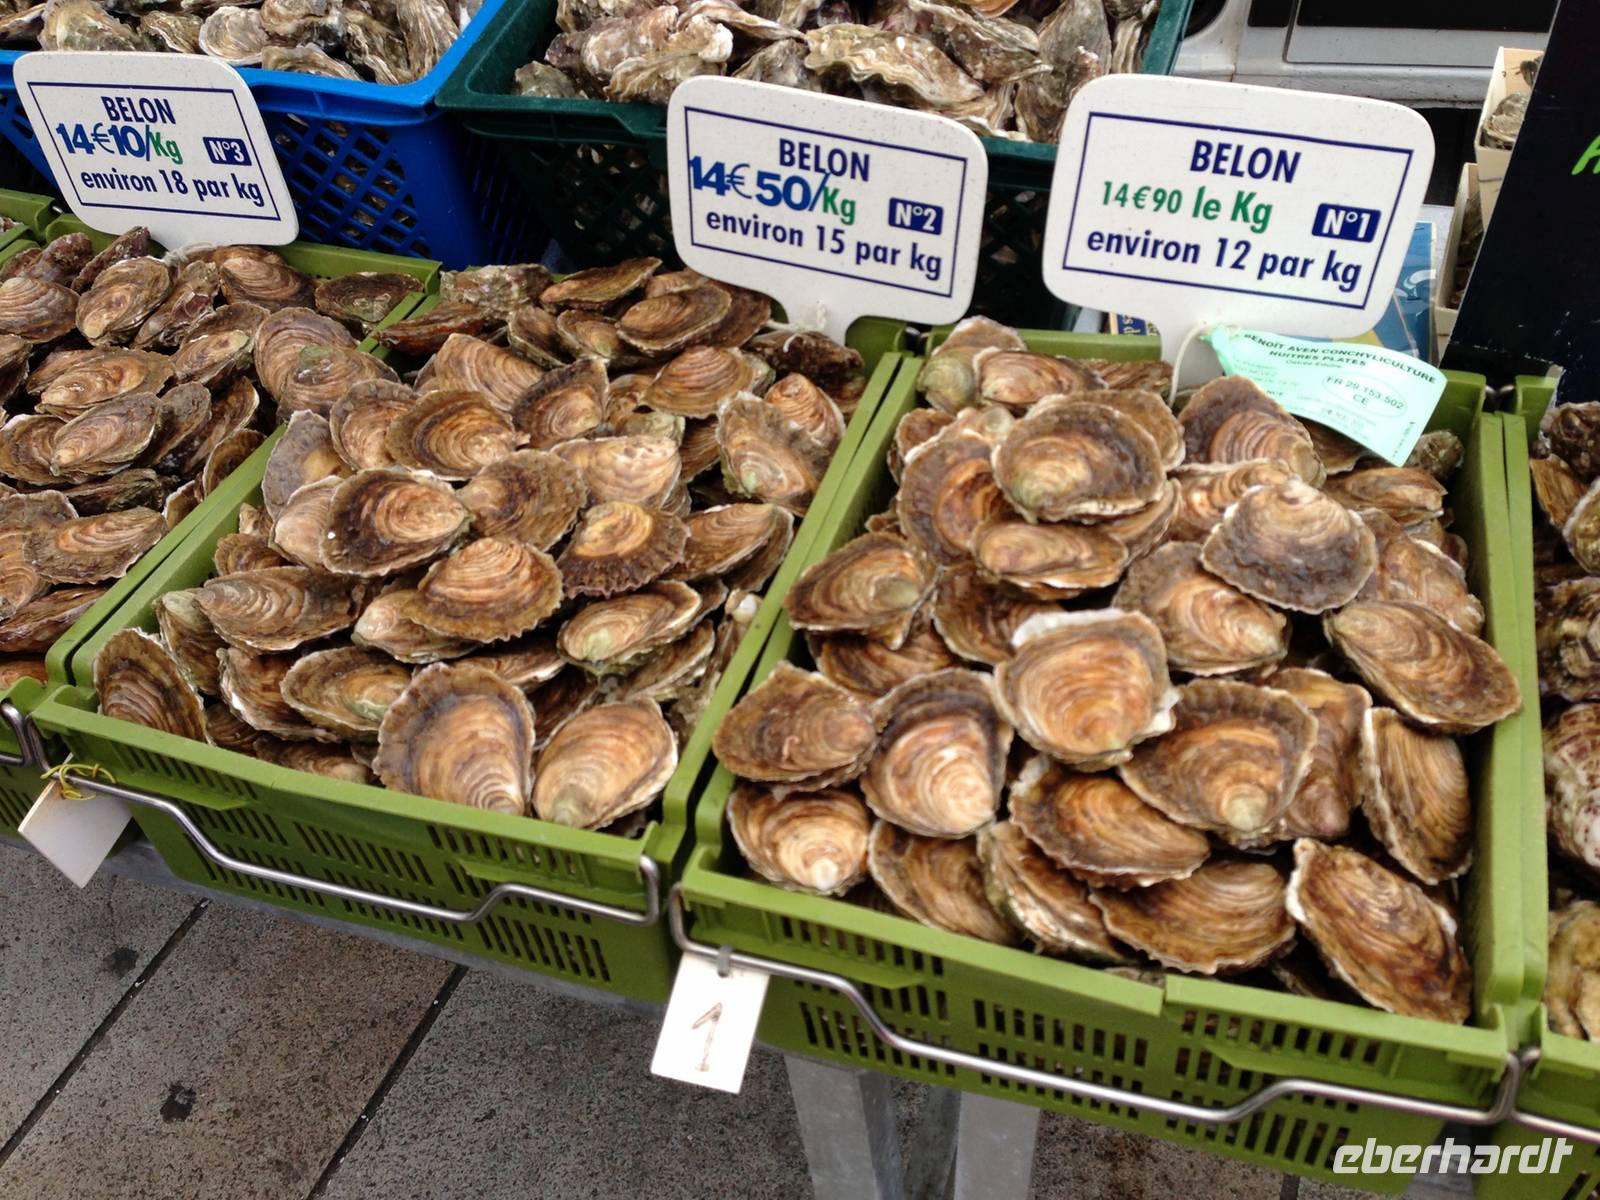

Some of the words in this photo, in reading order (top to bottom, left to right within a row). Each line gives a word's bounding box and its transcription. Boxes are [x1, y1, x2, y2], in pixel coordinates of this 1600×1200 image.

[101, 96, 176, 124] BELON
[208, 140, 246, 163] N°3
[779, 138, 870, 181] BELON
[1190, 140, 1301, 183] BELON
[80, 167, 157, 193] environ
[159, 169, 188, 194] 18
[192, 175, 230, 201] par
[231, 173, 264, 207] kg
[895, 203, 936, 232] N°2
[1103, 180, 1183, 214] 14€90
[1191, 185, 1222, 220] le
[1231, 190, 1273, 234] Kg
[1322, 208, 1371, 239] N°1
[706, 210, 803, 247] environ
[816, 225, 845, 254] 15
[856, 241, 900, 265] par
[910, 242, 941, 281] kg
[1087, 230, 1201, 264] environ
[1215, 237, 1252, 270] 12
[1257, 251, 1314, 280] par
[1322, 250, 1362, 293] kg
[1288, 346, 1319, 355] AVEN
[1322, 356, 1367, 367] PLATES
[1353, 393, 1370, 406] CE
[691, 1002, 722, 1072] 1
